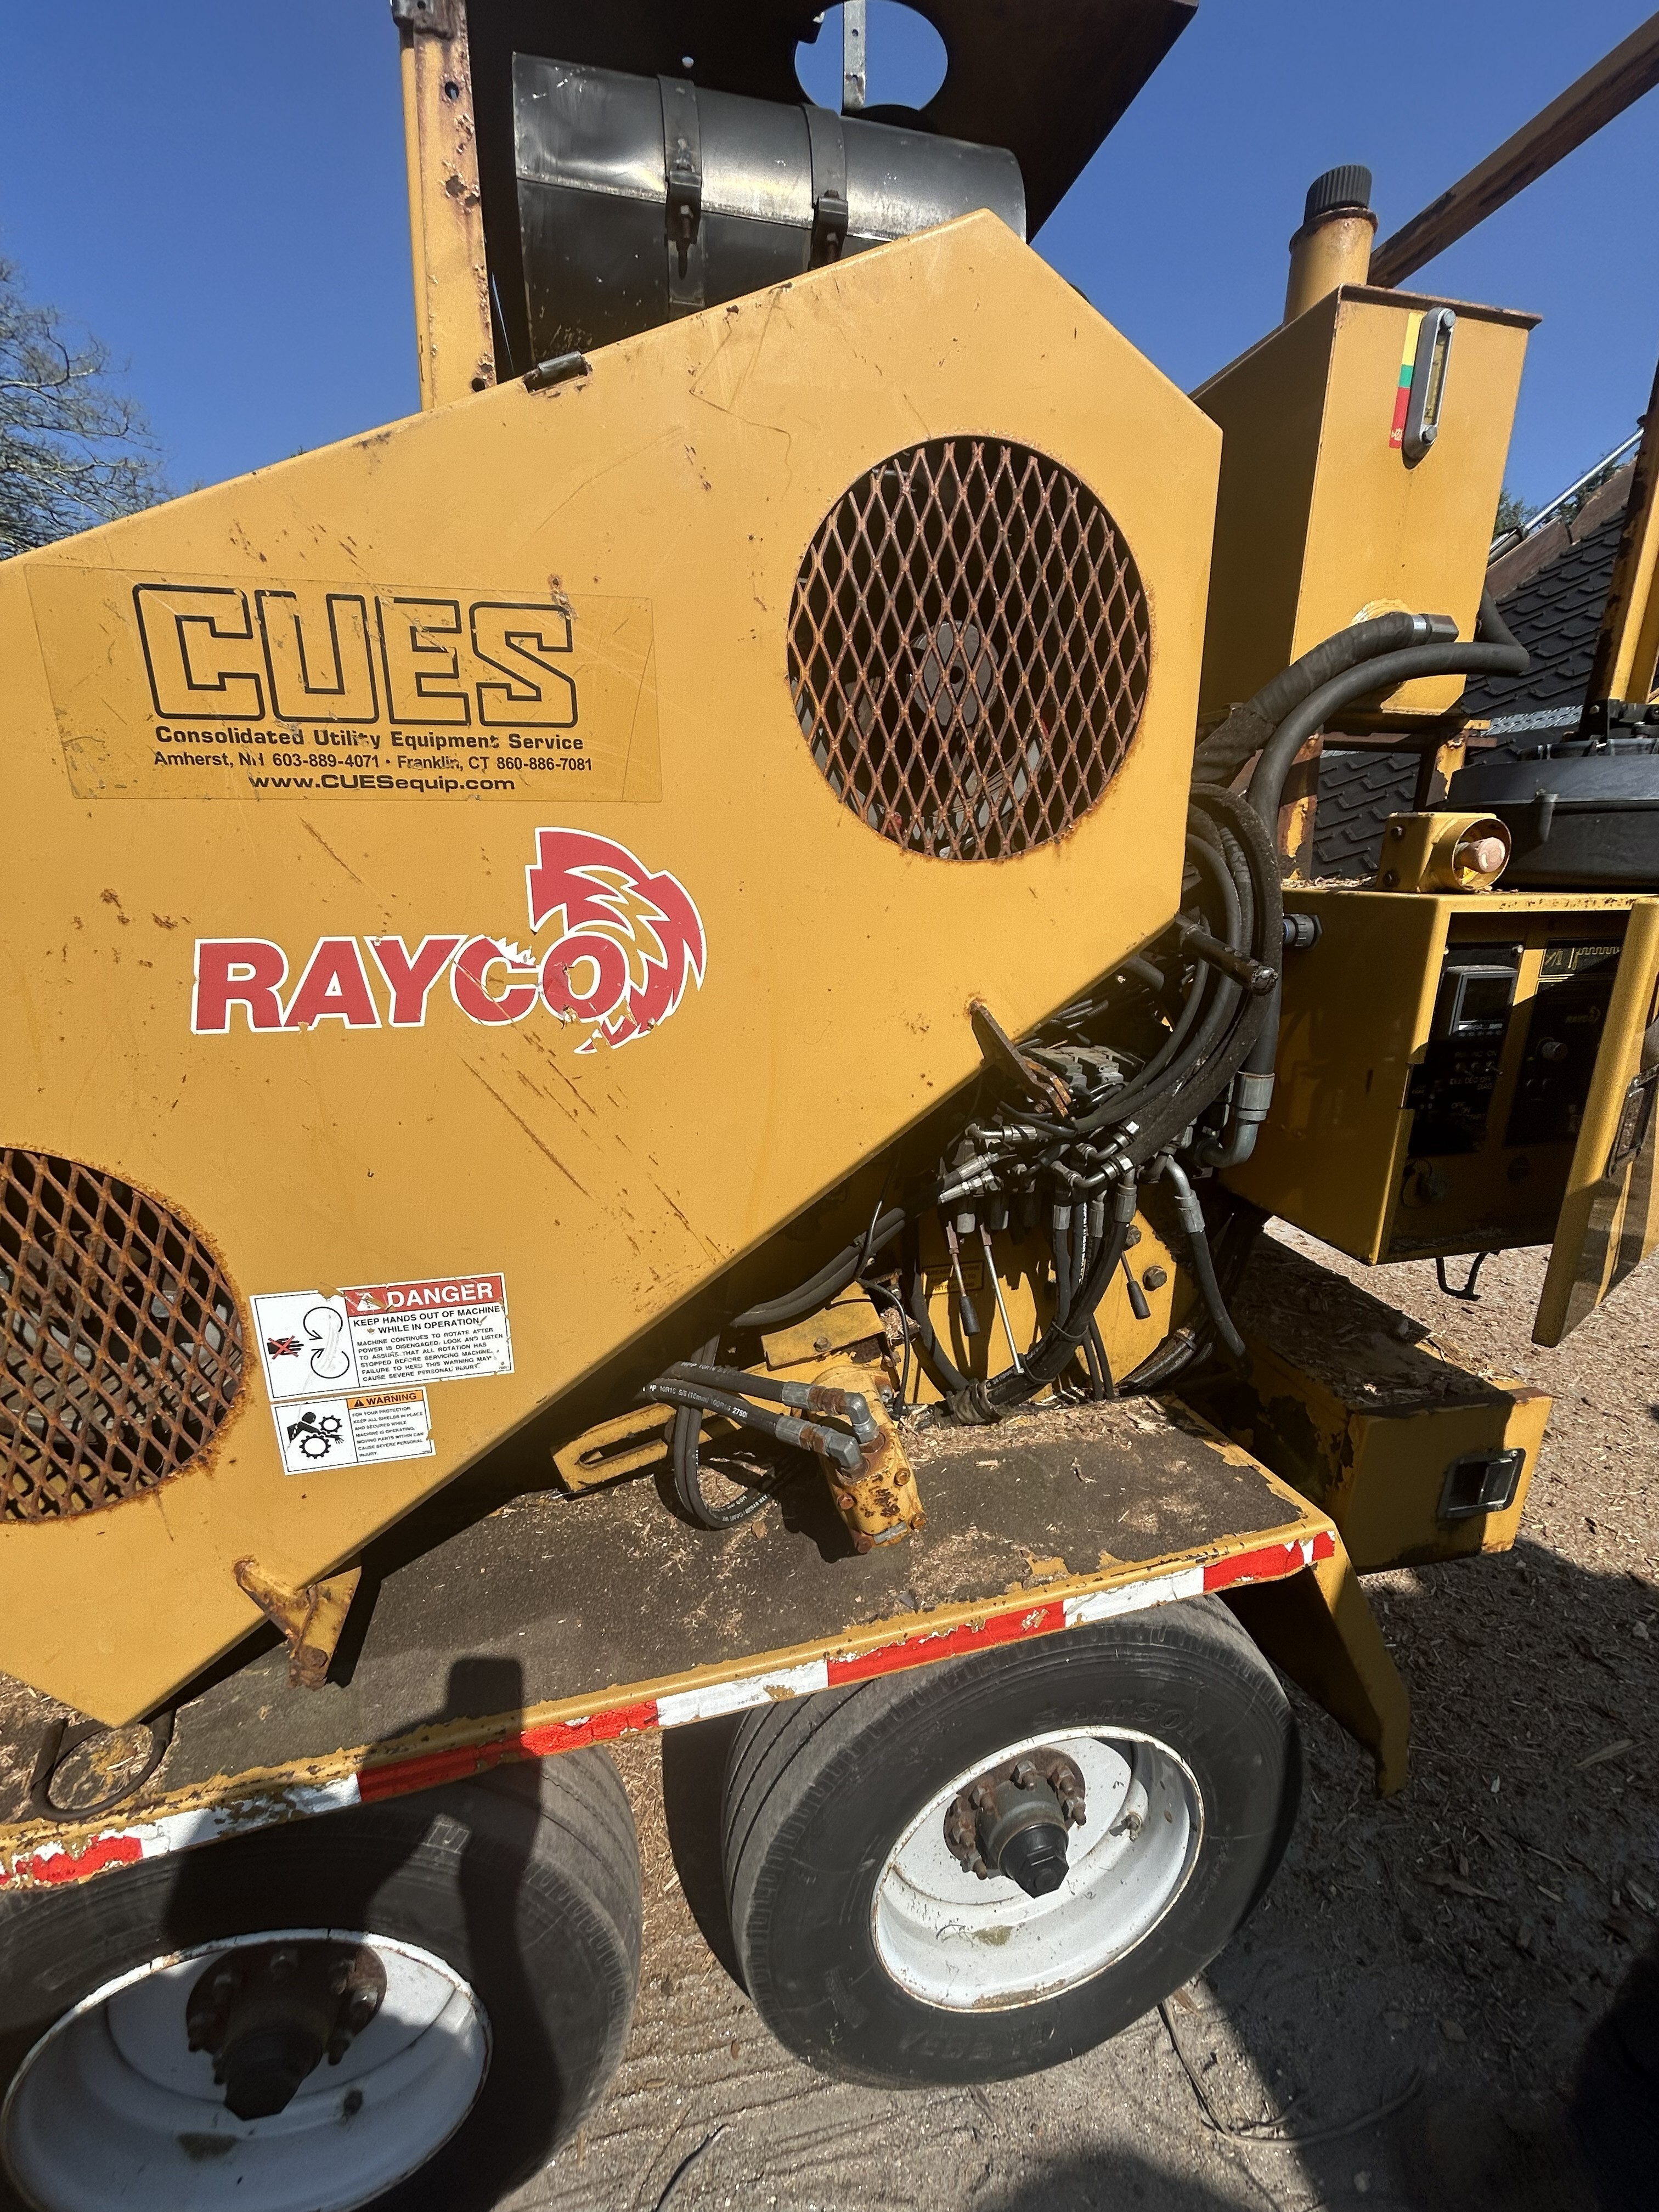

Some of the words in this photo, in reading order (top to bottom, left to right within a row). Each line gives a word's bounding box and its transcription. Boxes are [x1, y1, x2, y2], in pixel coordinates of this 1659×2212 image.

[133, 583, 579, 728] CUES
[156, 726, 304, 744] Consolidated
[314, 729, 380, 749] Utility
[391, 731, 499, 750] Equipment
[509, 733, 583, 749] Service
[155, 751, 233, 768] Amherst,
[273, 753, 379, 767] 603-889-4071
[398, 755, 463, 771] Franklin,
[469, 757, 489, 769] CT
[496, 757, 592, 771] 860-886-7081
[249, 774, 515, 792] www.CUESequip.com
[190, 934, 630, 1034] RAYCO
[387, 1282, 493, 1308] DANGER
[353, 1318, 380, 1327] KEEP
[383, 1313, 416, 1324] HANDS
[420, 1312, 439, 1321] OUT
[458, 1306, 500, 1316] MACHINE
[378, 1324, 409, 1334] WHILE
[391, 1335, 428, 1343] CONTINUES
[425, 1352, 459, 1361] SERVICING
[366, 1393, 416, 1405] WARNING
